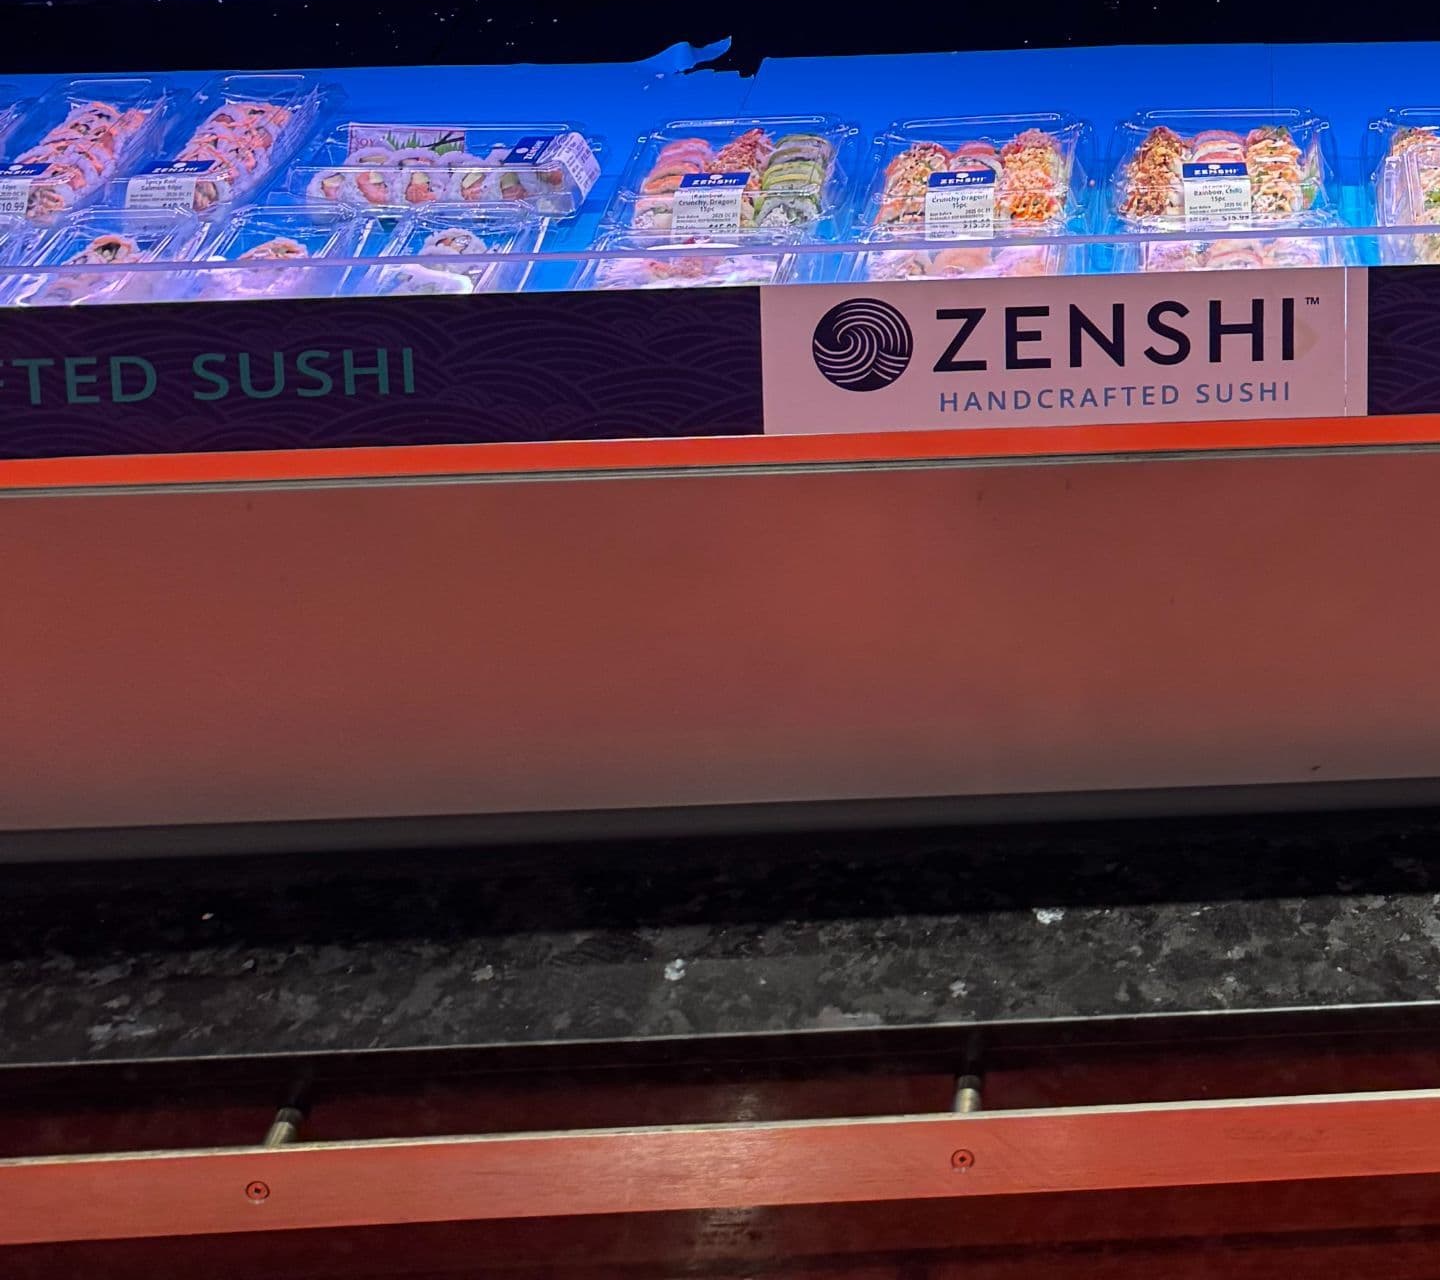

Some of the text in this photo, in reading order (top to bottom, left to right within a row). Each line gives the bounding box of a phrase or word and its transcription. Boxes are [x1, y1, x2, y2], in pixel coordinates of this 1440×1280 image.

[932, 298, 1296, 373] ZENSHI
[0, 347, 415, 405] TED SUSHI
[939, 381, 1291, 413] HANDCRAFTED SUSHI
